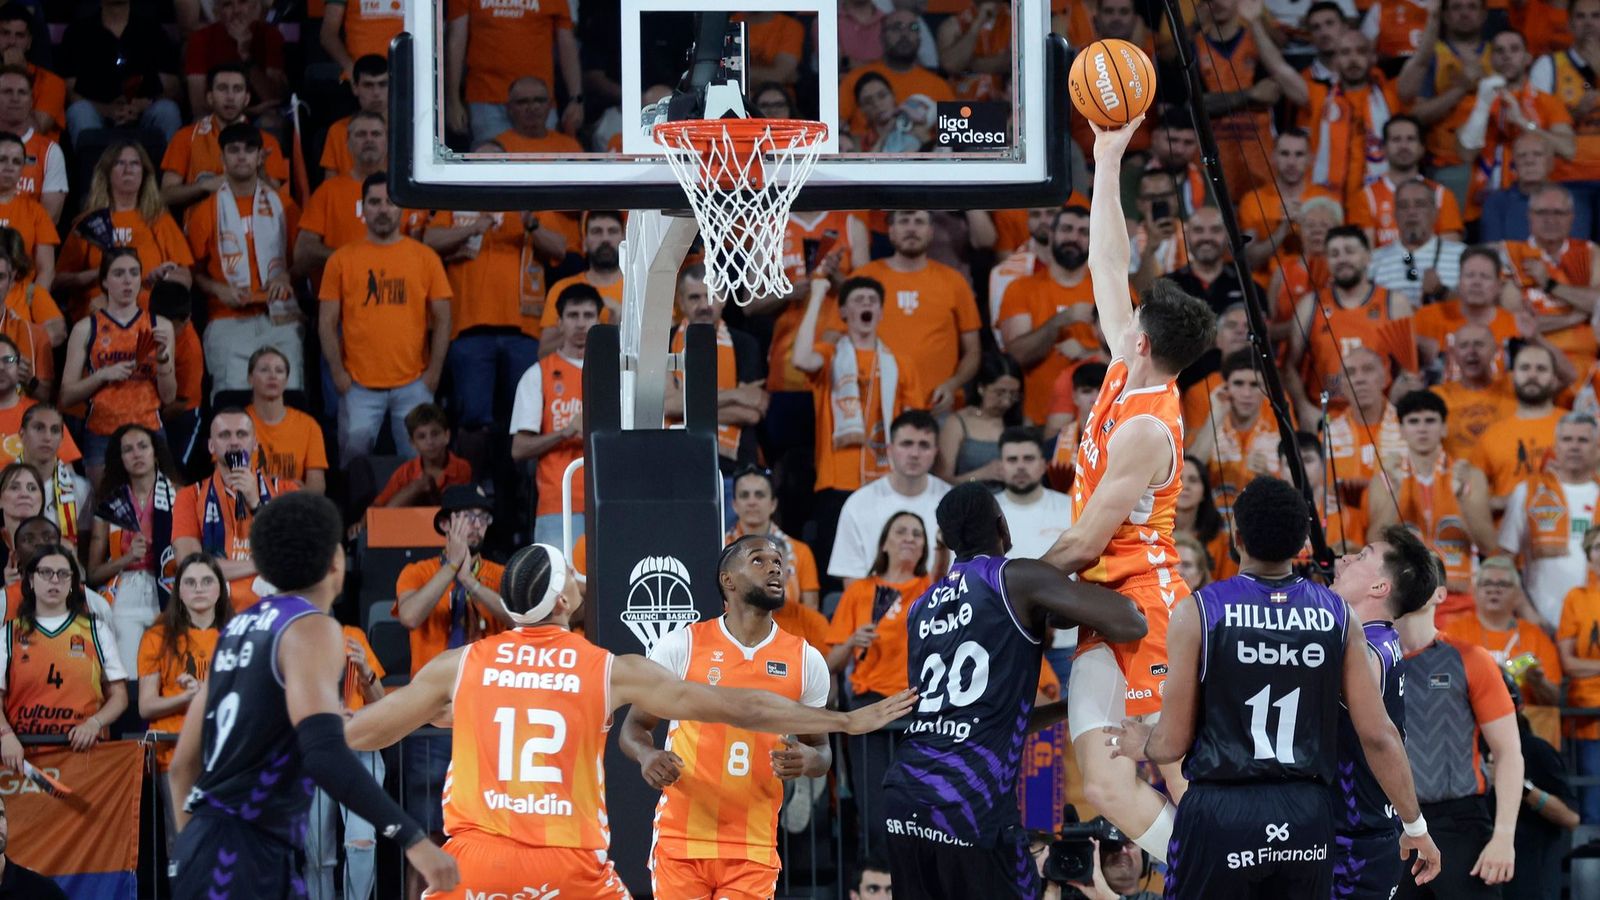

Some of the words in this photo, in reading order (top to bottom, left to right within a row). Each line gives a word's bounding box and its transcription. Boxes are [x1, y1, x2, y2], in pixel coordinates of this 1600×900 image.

[1094, 52, 1120, 111] Wilson
[939, 114, 968, 131] liga
[939, 128, 1005, 144] endesa
[666, 612, 695, 620] BASKET
[1224, 603, 1335, 632] HILLIARD
[495, 642, 577, 669] SAKO
[46, 662, 64, 690] 4
[482, 667, 581, 693] PAMESA
[917, 640, 990, 713] 20
[1245, 684, 1300, 764] 11
[493, 706, 568, 783] 12
[727, 740, 750, 776] 8
[483, 788, 573, 816] Vitaldin
[886, 818, 905, 835] SR
[1226, 849, 1255, 869] SR
[1257, 843, 1327, 865] Financial
